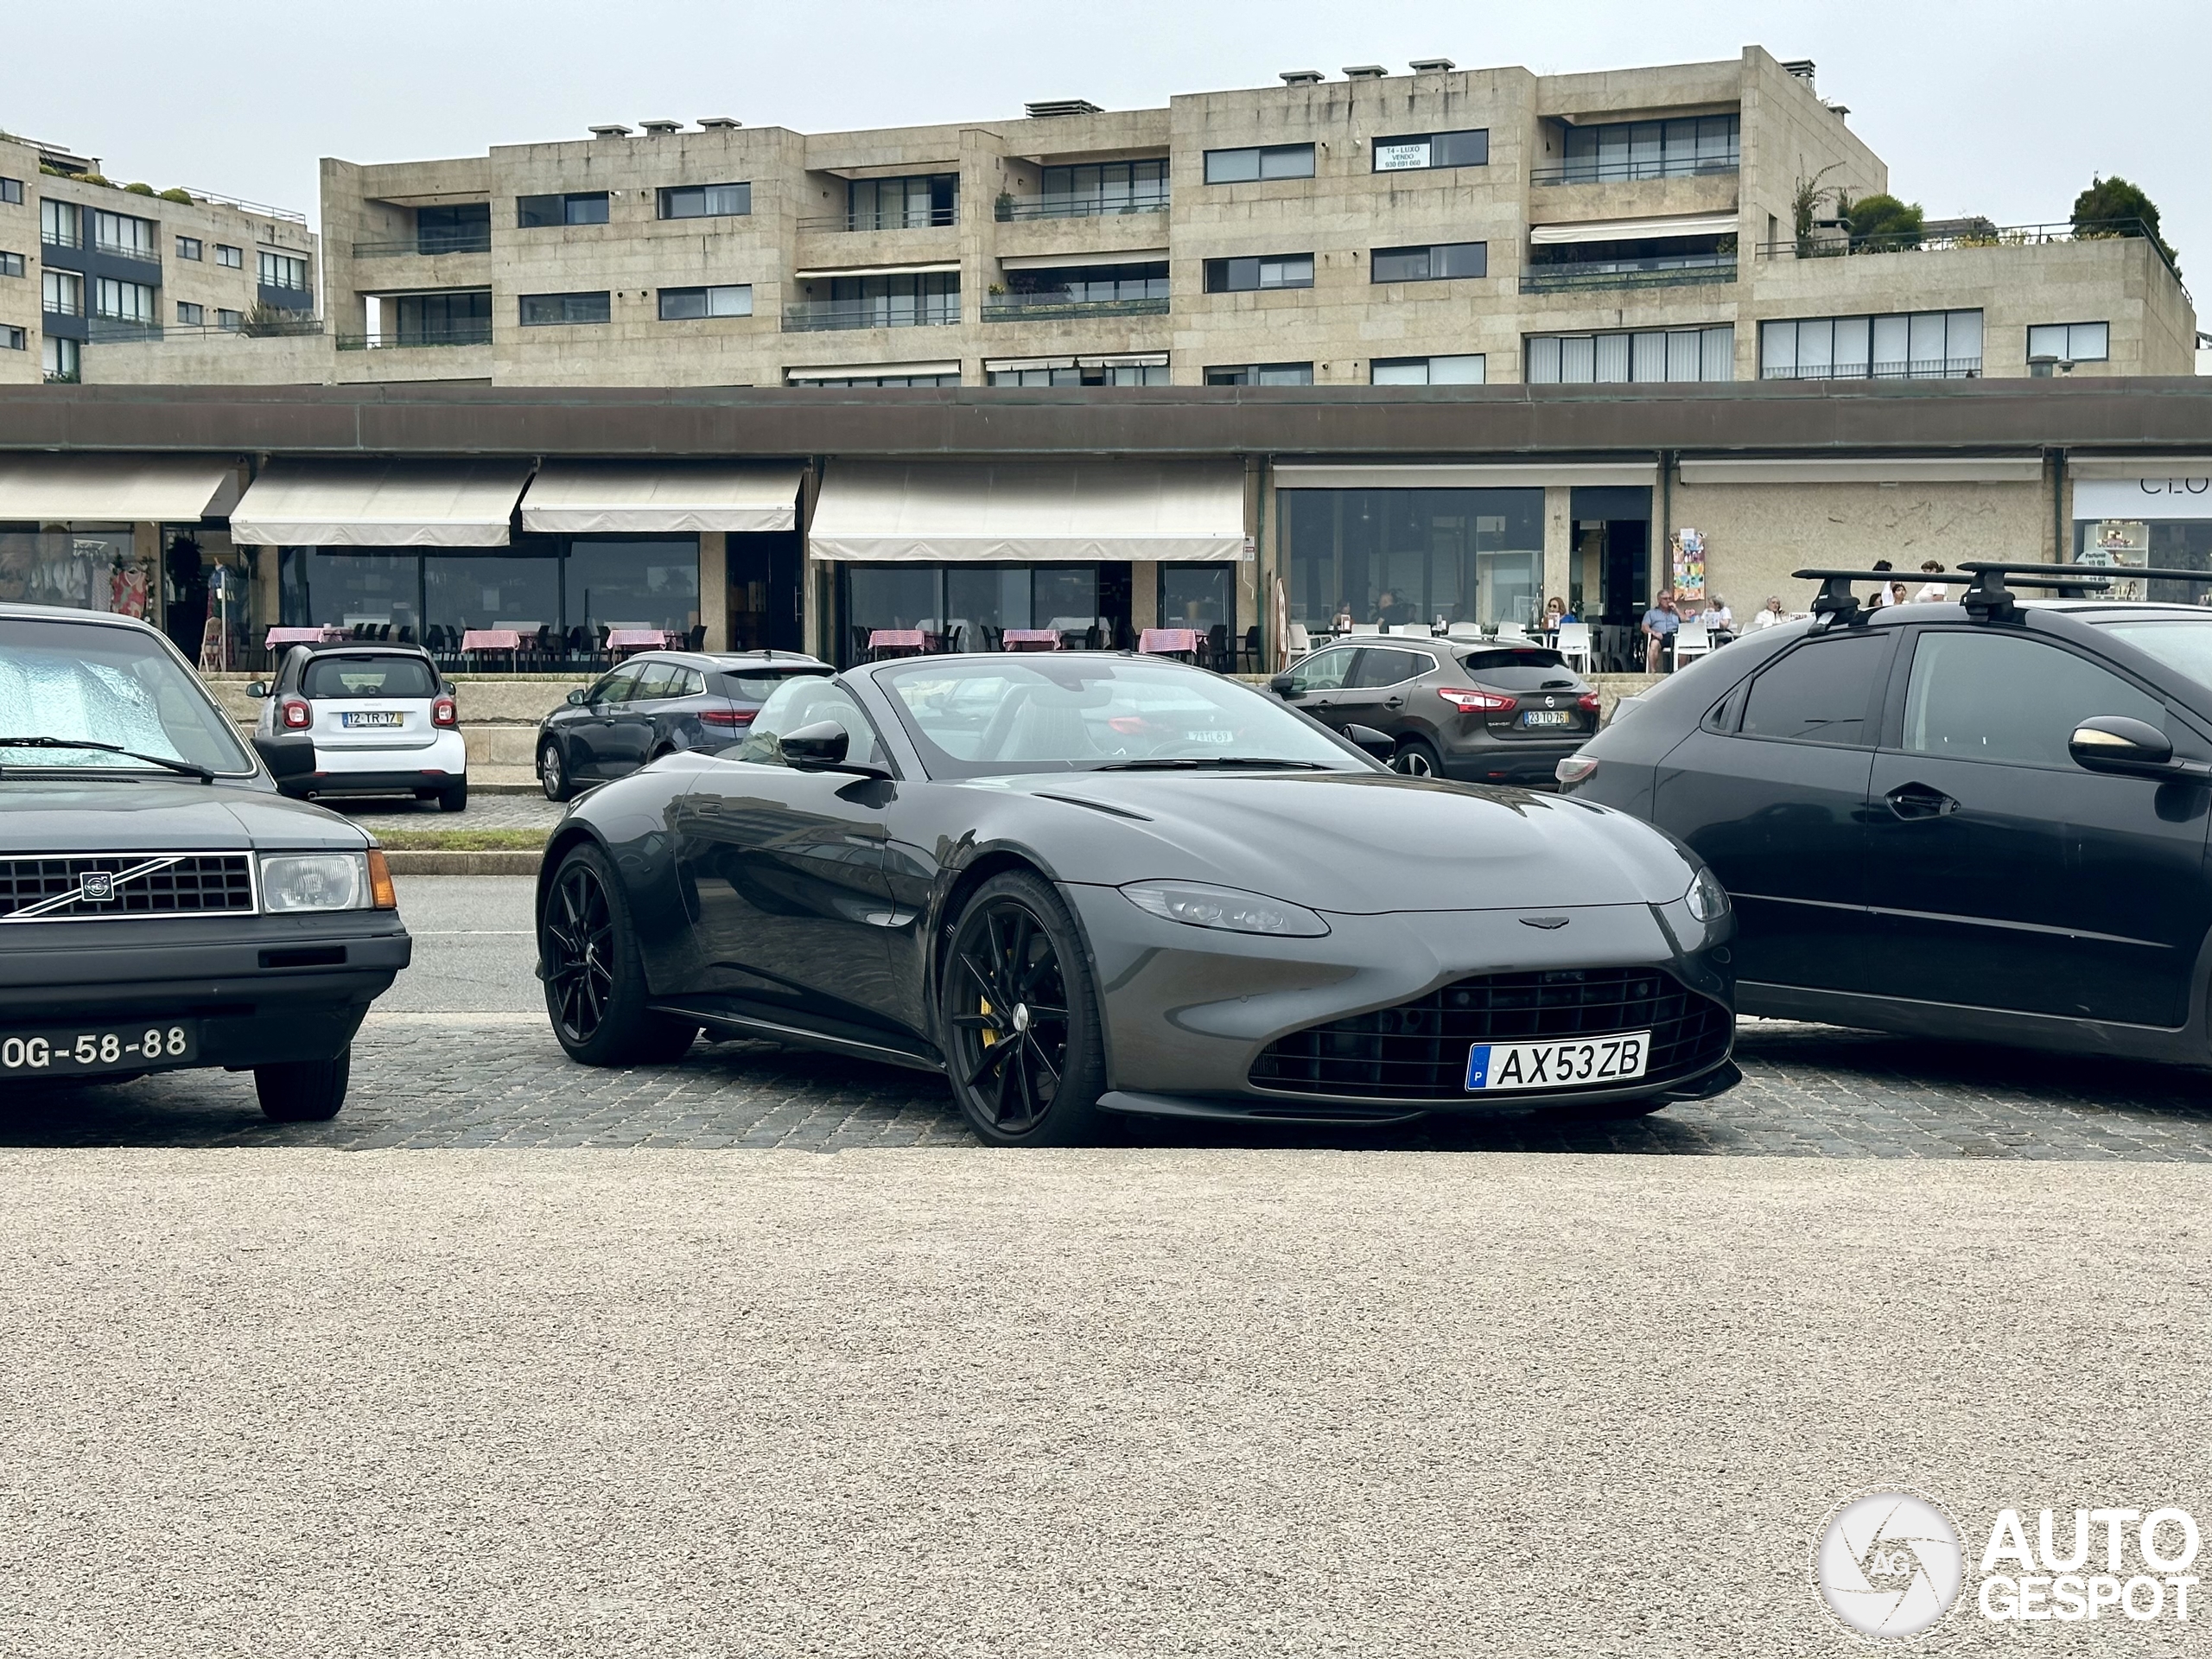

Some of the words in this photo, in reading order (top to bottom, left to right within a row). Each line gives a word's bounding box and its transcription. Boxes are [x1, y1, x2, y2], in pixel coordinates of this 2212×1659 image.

[349, 713, 360, 723] 12
[365, 713, 379, 723] TR
[385, 713, 396, 723] 17
[1529, 712, 1540, 723] 23
[1541, 712, 1553, 722] TD
[2, 1027, 187, 1068] OG-58-88
[1497, 1039, 1641, 1085] AX53ZB
[1474, 1071, 1483, 1082] P
